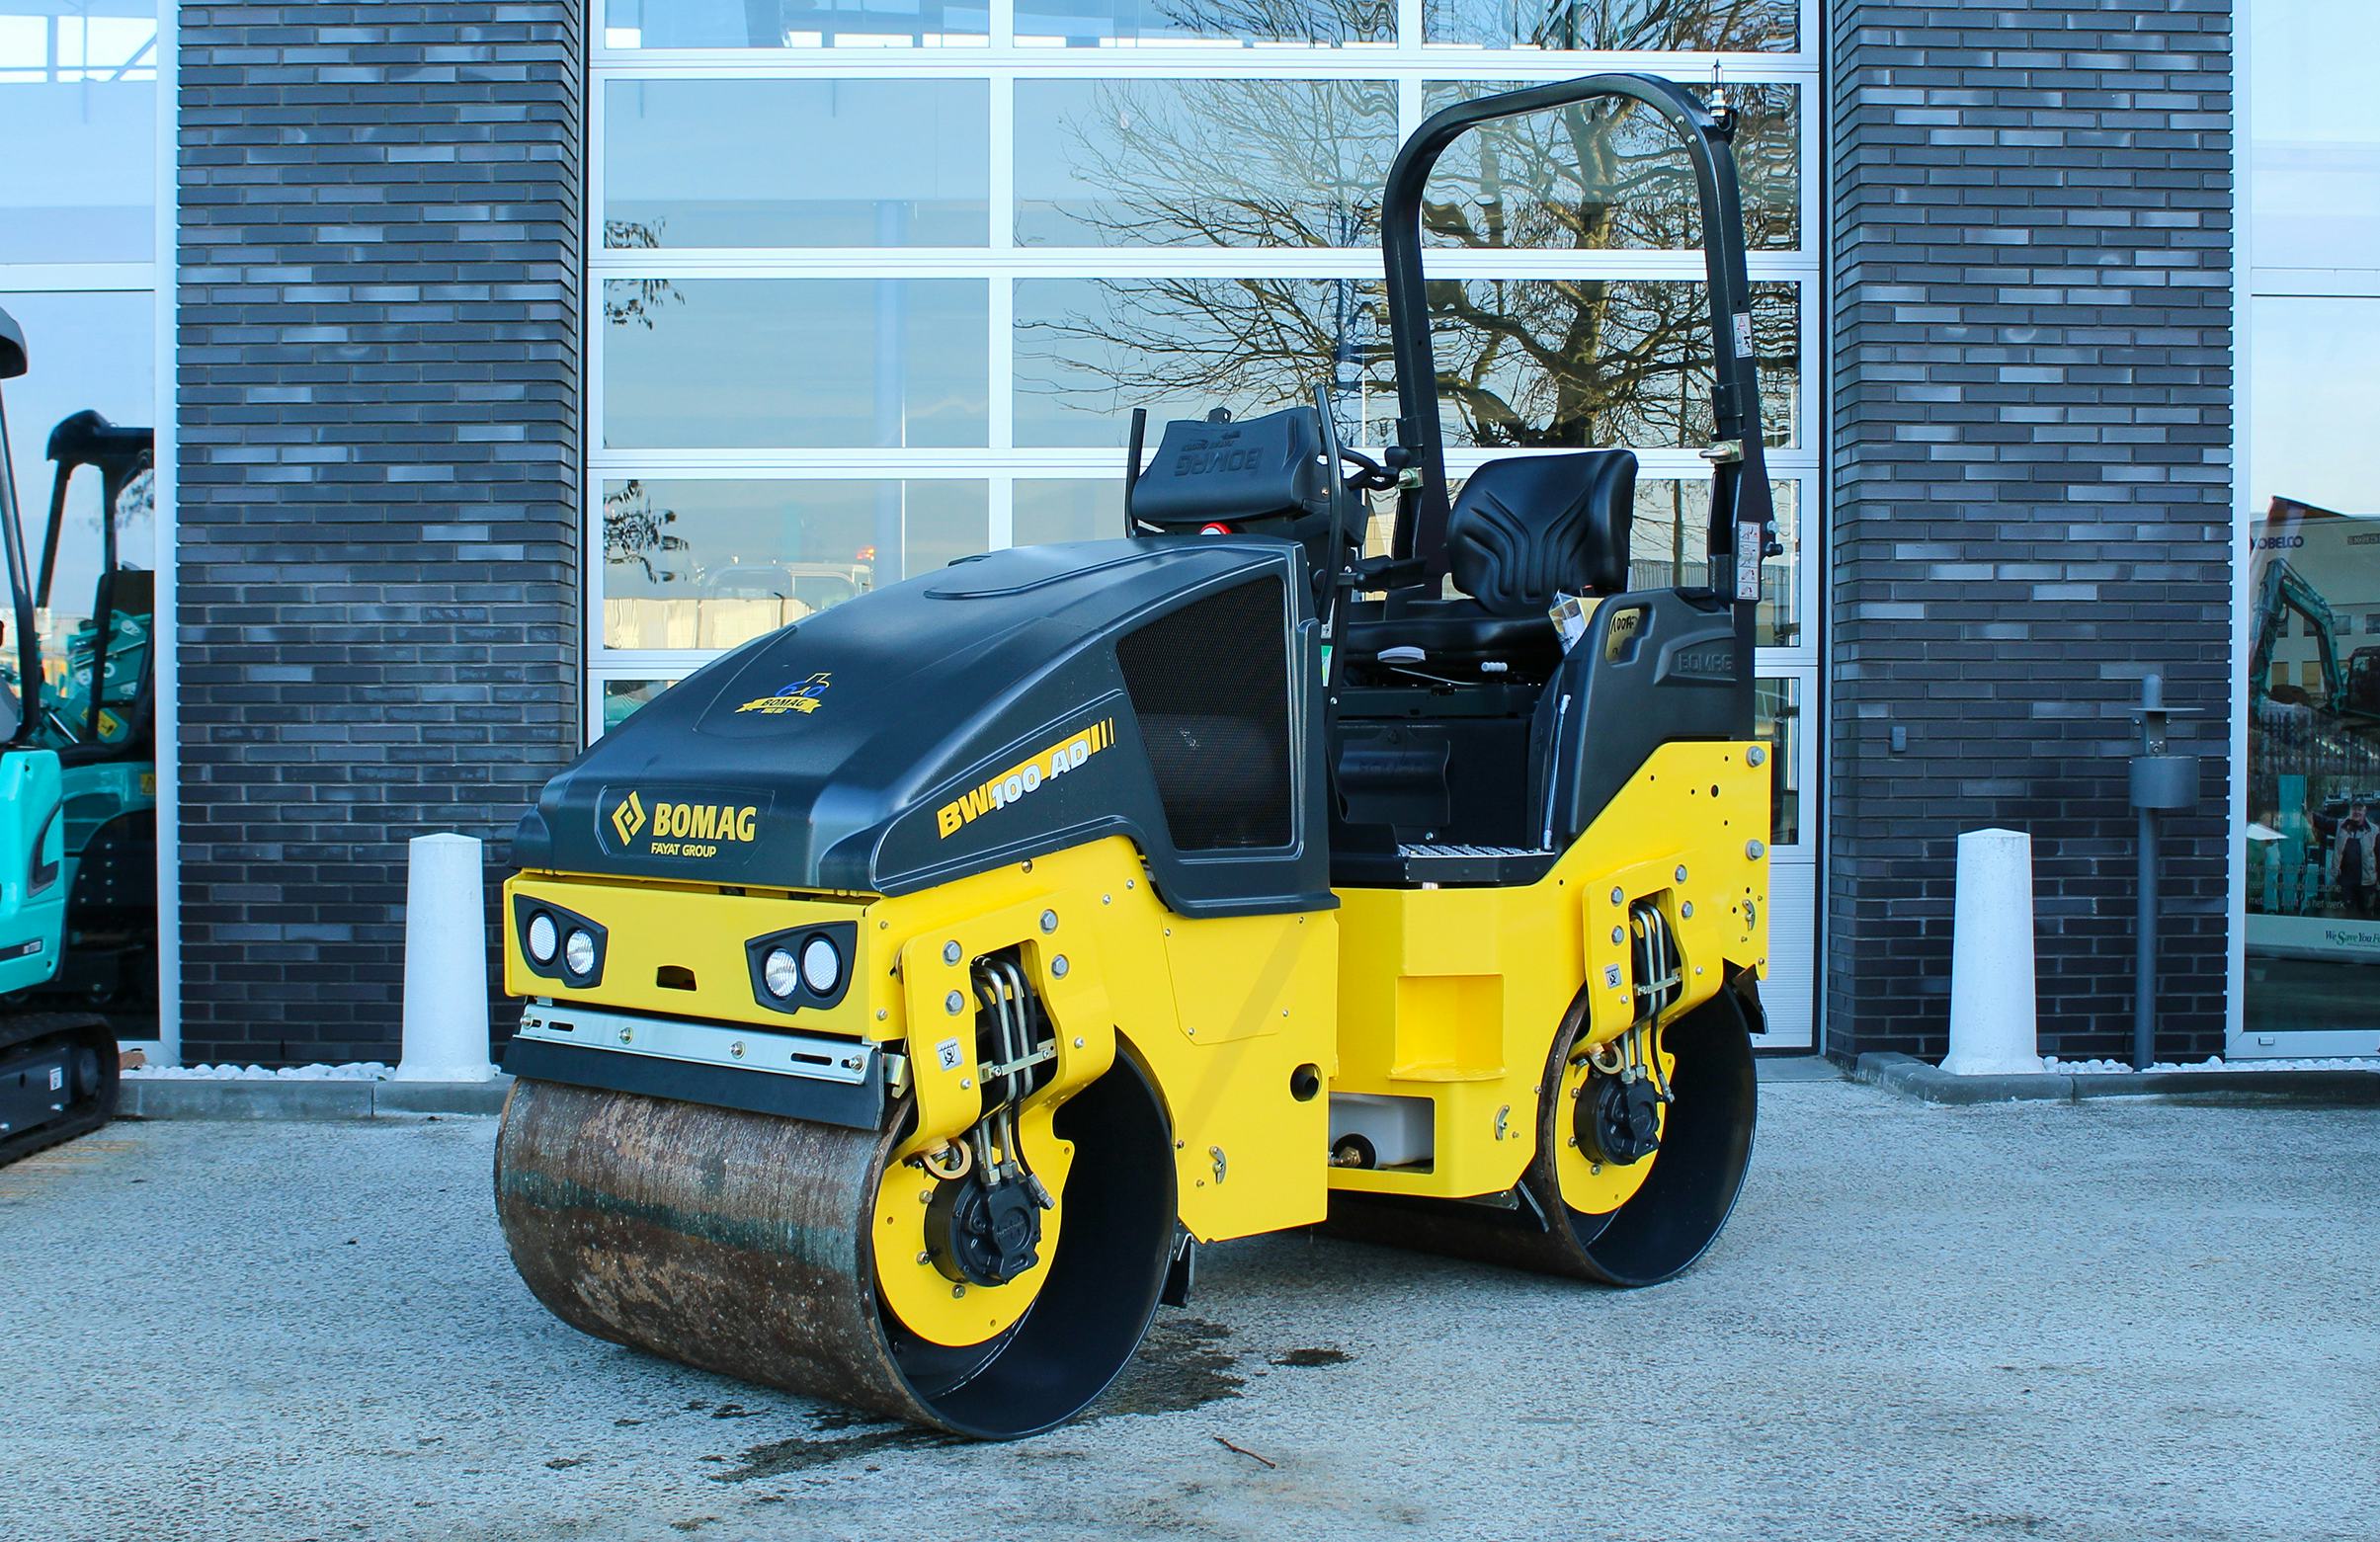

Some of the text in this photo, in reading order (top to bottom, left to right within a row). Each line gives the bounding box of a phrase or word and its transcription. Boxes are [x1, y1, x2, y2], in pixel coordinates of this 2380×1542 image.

[761, 698, 809, 707] BOMAG
[1049, 739, 1090, 781] AD
[653, 803, 757, 843] BOMAG
[651, 843, 717, 858] FAYAT GROUP
[2358, 933, 2372, 943] You
